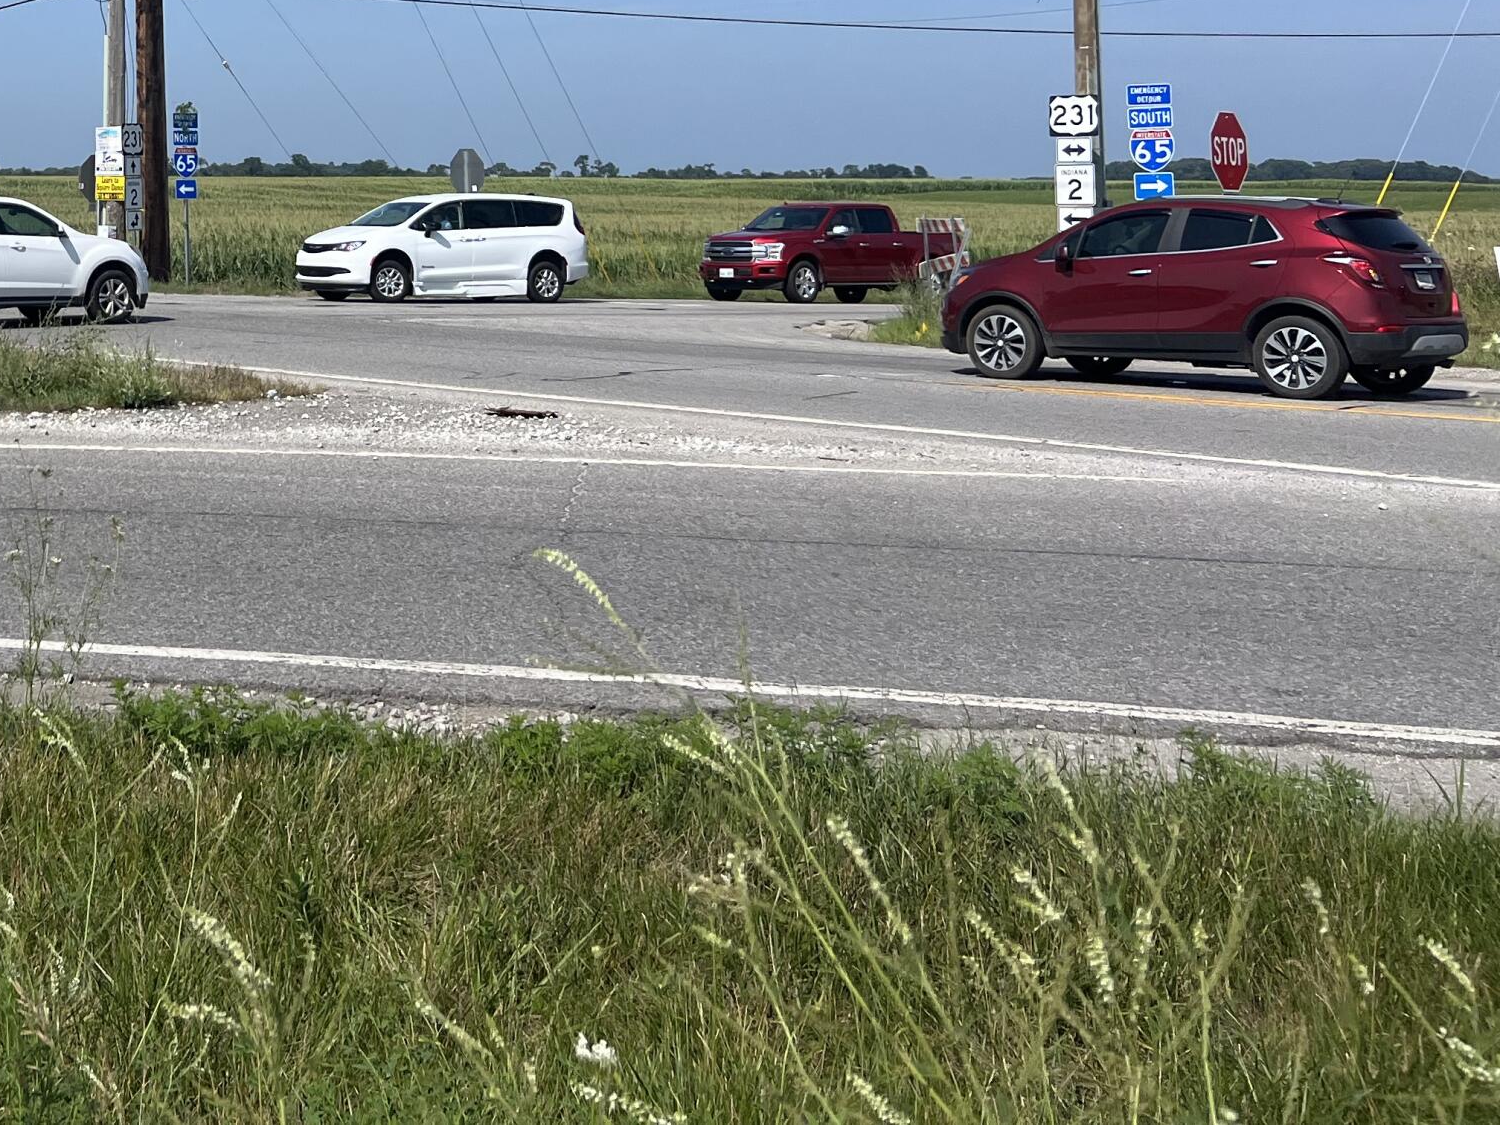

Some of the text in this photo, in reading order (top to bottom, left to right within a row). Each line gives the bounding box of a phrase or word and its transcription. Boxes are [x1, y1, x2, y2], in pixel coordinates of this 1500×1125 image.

[1130, 86, 1167, 95] EMERGENCY
[1137, 95, 1162, 103] DETOUR
[1053, 104, 1094, 126] 231
[1130, 110, 1171, 124] SOUTH
[123, 131, 142, 148] 231
[1135, 131, 1167, 139] INTERSTATE
[1134, 140, 1172, 164] 65
[1213, 136, 1245, 166] STOP
[176, 155, 196, 172] 65
[130, 188, 138, 206] 2
[1067, 179, 1083, 200] 2
